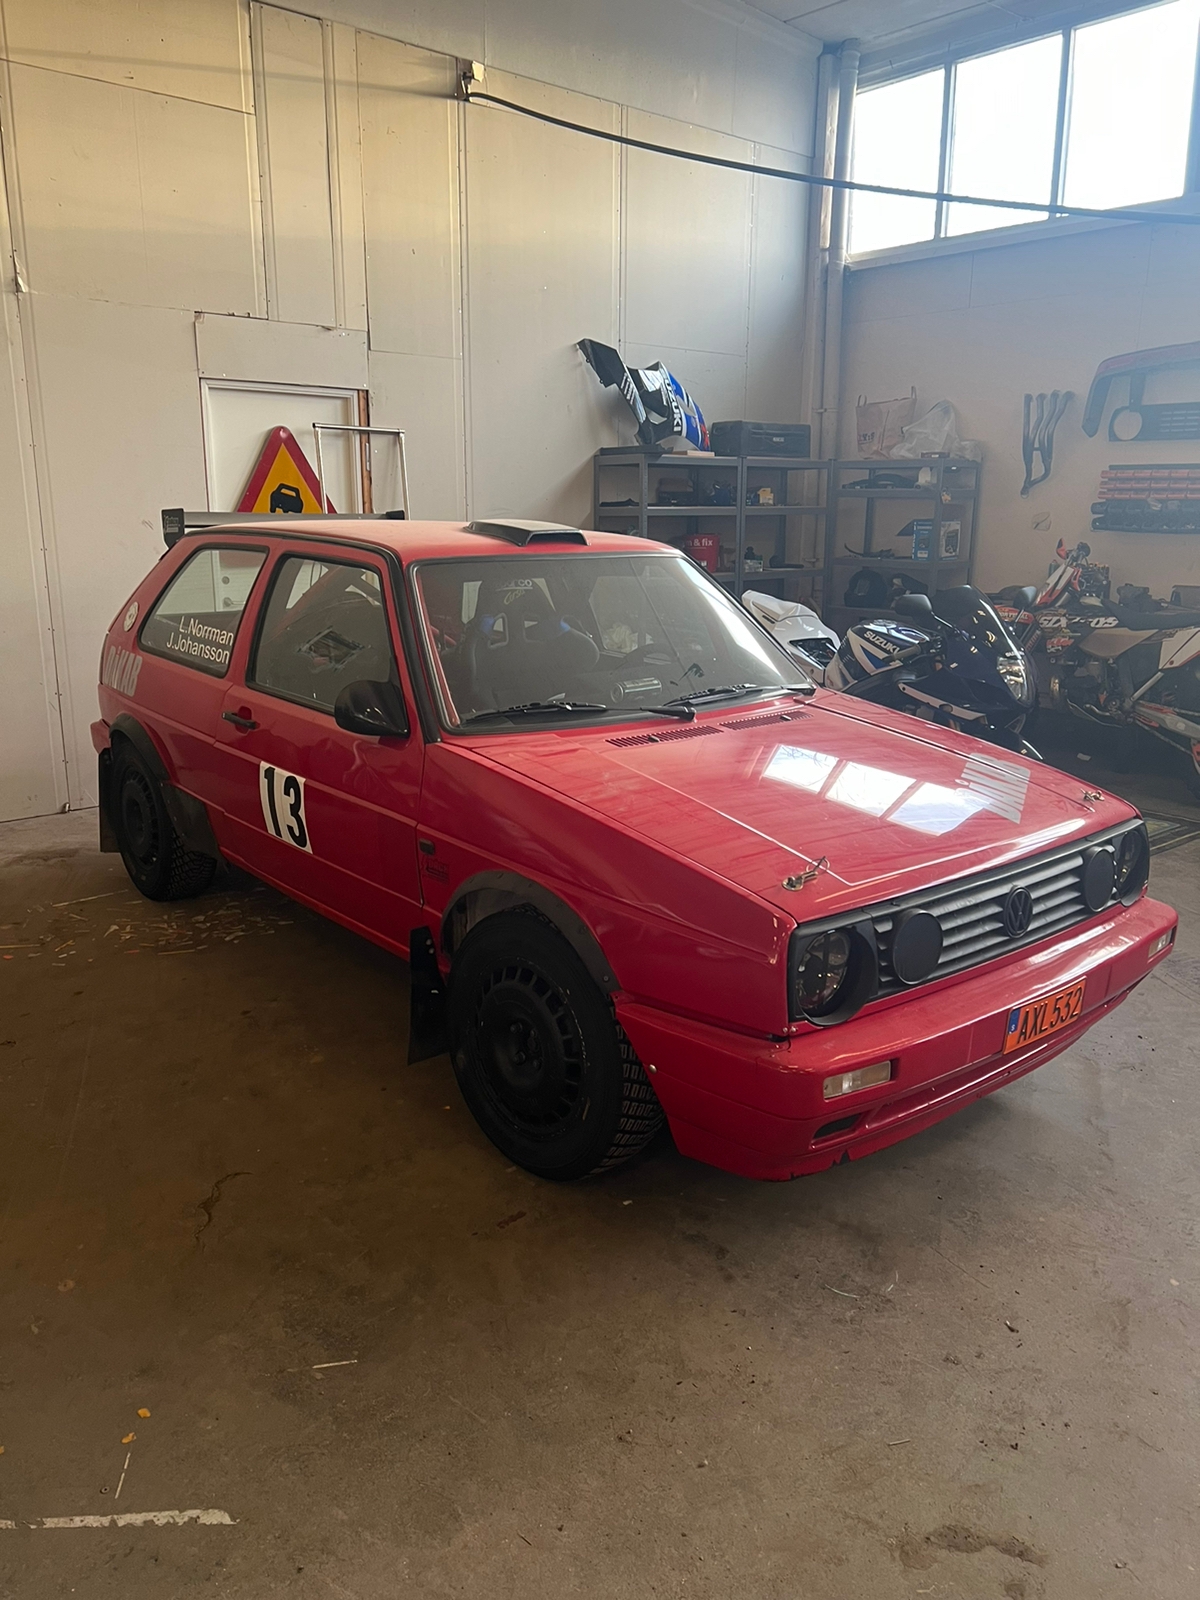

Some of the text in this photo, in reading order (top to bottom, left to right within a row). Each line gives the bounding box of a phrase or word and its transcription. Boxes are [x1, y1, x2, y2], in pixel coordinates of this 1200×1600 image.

[661, 369, 682, 432] UZUKI
[702, 538, 713, 547] fix
[179, 616, 234, 646] L.Norrman
[863, 630, 901, 655] SUZUKI
[166, 632, 230, 664] J.Johansson
[264, 766, 307, 848] 13
